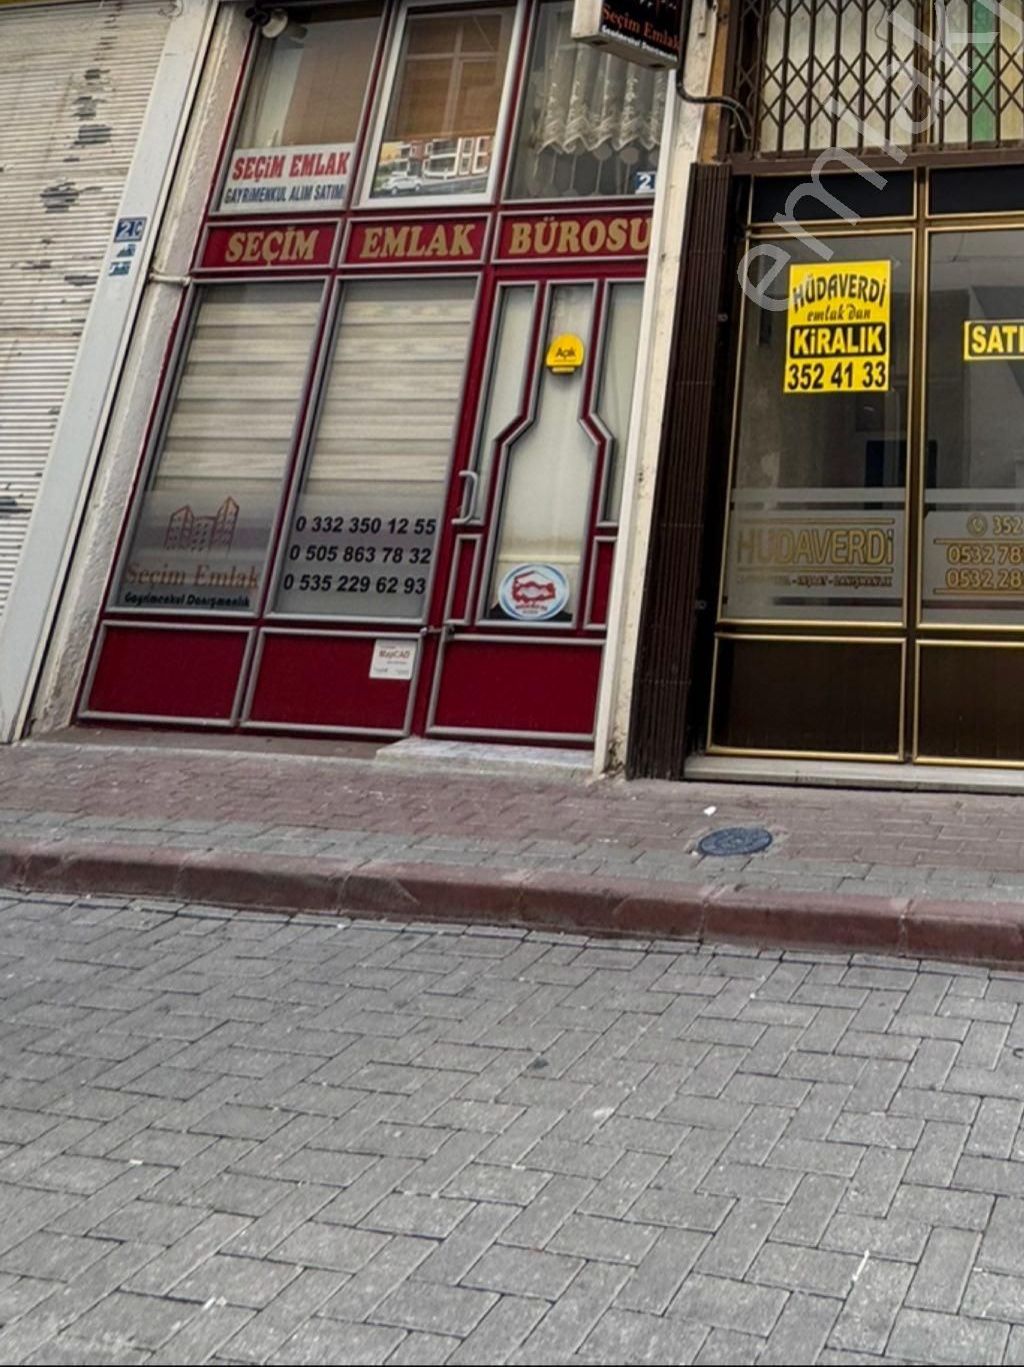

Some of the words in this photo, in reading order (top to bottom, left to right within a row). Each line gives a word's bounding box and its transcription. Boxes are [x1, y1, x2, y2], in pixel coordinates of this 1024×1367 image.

[289, 152, 350, 177] EMLAK
[225, 226, 319, 266] SEÇİM
[360, 224, 475, 258] EMLAK
[509, 217, 654, 254] BÜROSU
[788, 363, 824, 390] 352
[831, 362, 853, 388] 41
[862, 361, 885, 388] 33
[296, 516, 306, 532] 0
[312, 516, 344, 533] 332
[349, 517, 381, 534] 350
[388, 518, 409, 534] 12
[414, 518, 436, 534] 55
[992, 515, 1021, 535] 352
[289, 545, 300, 561] 0
[305, 545, 338, 562] 505
[343, 546, 376, 563] 863
[382, 547, 403, 563] 78
[409, 548, 431, 564] 32
[947, 545, 994, 565] 0532
[283, 573, 294, 590] 0
[299, 574, 332, 591] 535
[337, 575, 370, 592] 229
[376, 577, 398, 593] 62
[404, 578, 426, 594] 93
[945, 569, 993, 588] 0532
